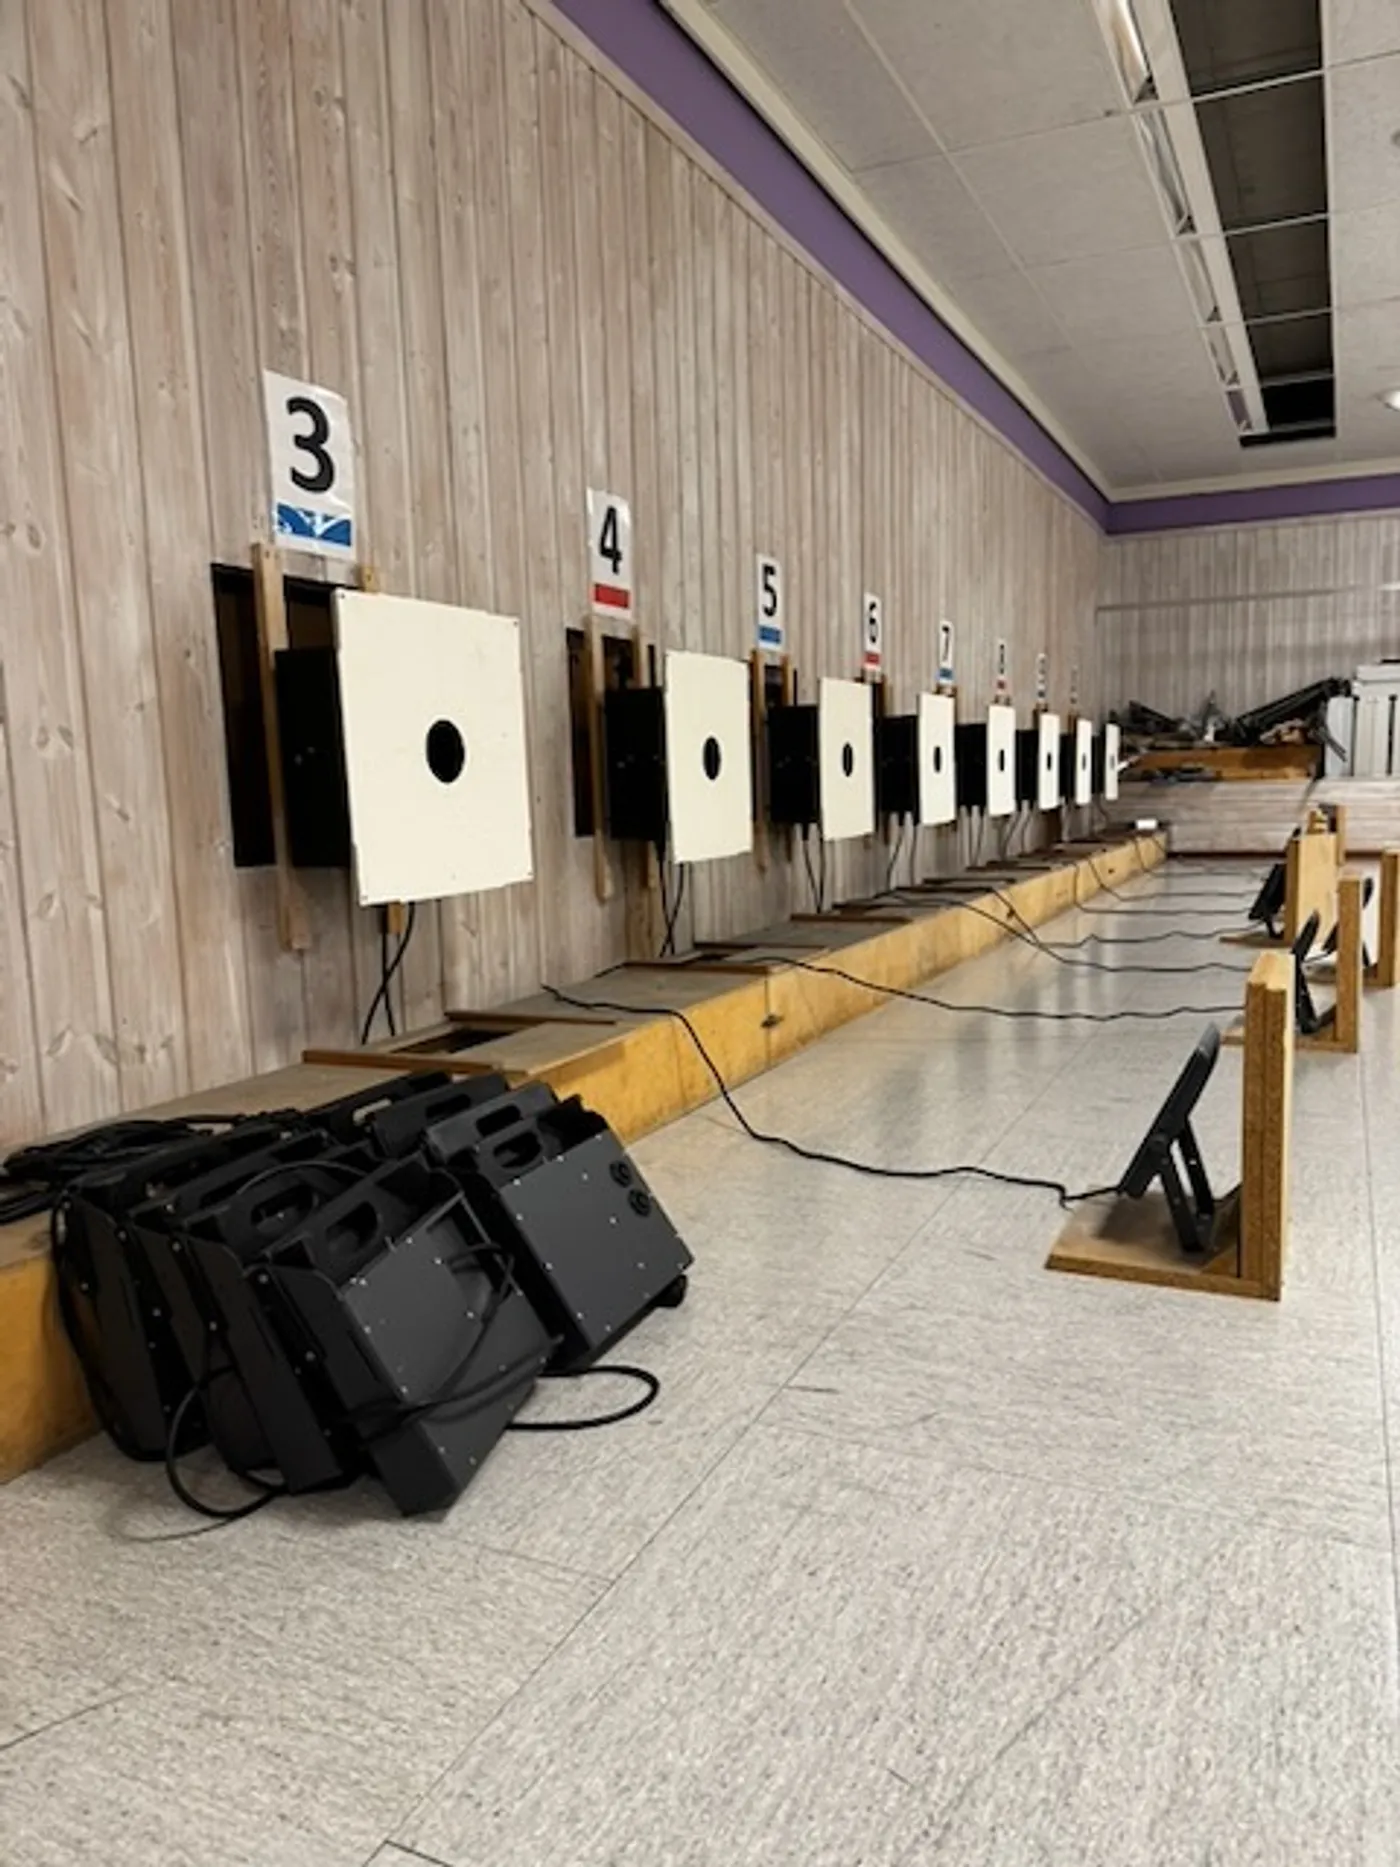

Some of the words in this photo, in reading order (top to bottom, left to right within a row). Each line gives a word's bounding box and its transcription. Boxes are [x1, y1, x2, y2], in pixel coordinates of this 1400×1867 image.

[285, 396, 336, 494] 3
[598, 505, 623, 575] 4
[762, 563, 778, 618] 5
[941, 624, 951, 662] 7
